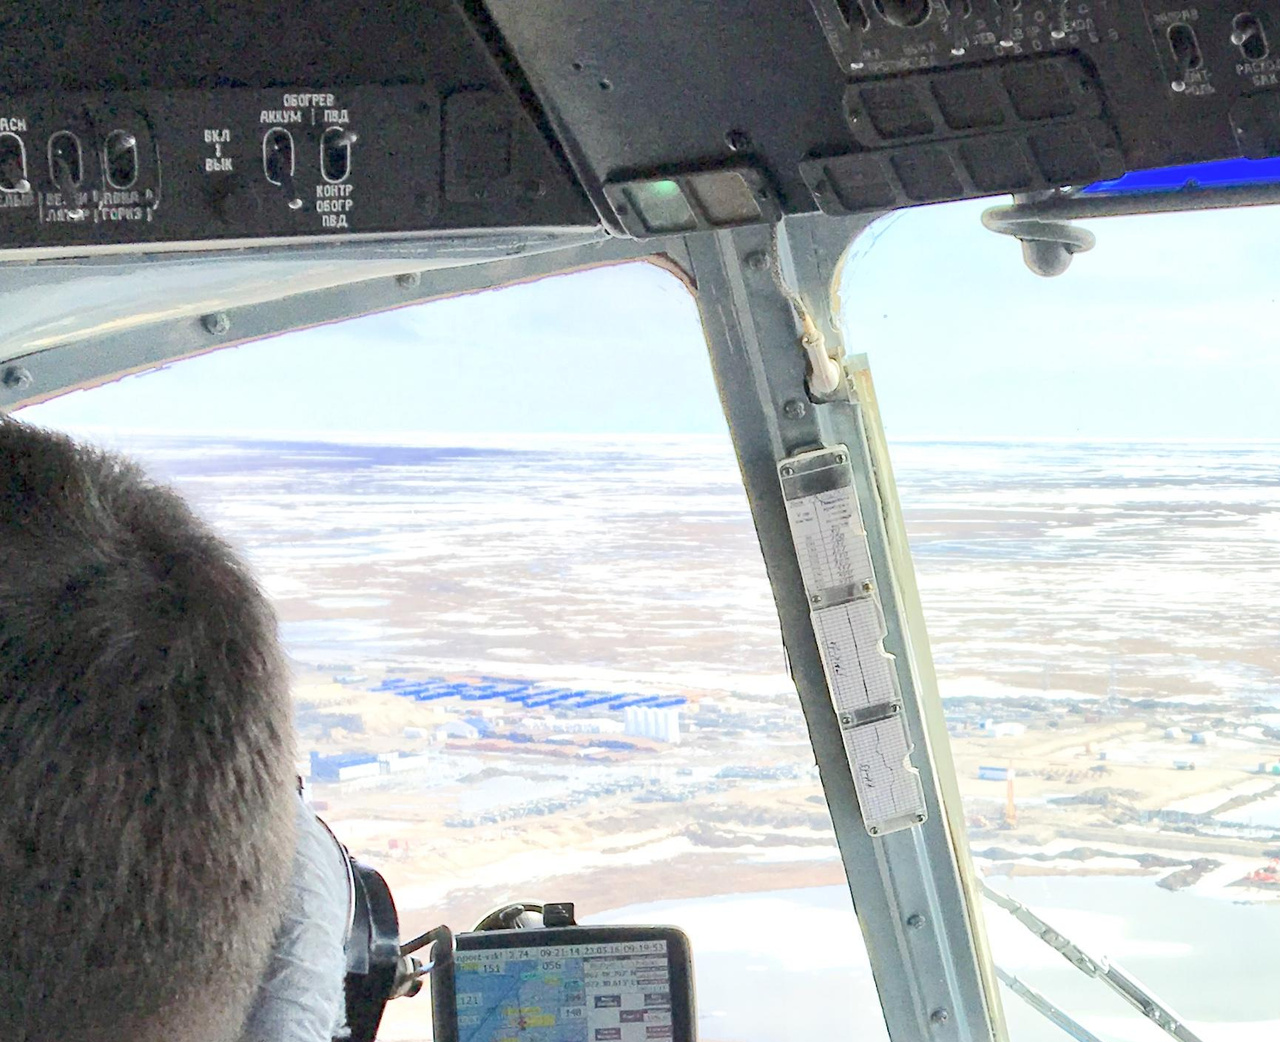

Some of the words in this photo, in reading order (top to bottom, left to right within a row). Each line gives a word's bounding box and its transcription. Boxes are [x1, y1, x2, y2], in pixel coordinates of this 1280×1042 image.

[283, 93, 335, 107] ОБОГРЕВ
[260, 110, 302, 123] АККУМ
[324, 109, 350, 123] ПВД
[204, 129, 231, 142] ВКЛ
[205, 157, 233, 171] ВЫК
[316, 184, 353, 197] КОНТР
[316, 199, 353, 212] ОБОГР
[322, 214, 348, 228] ПВД
